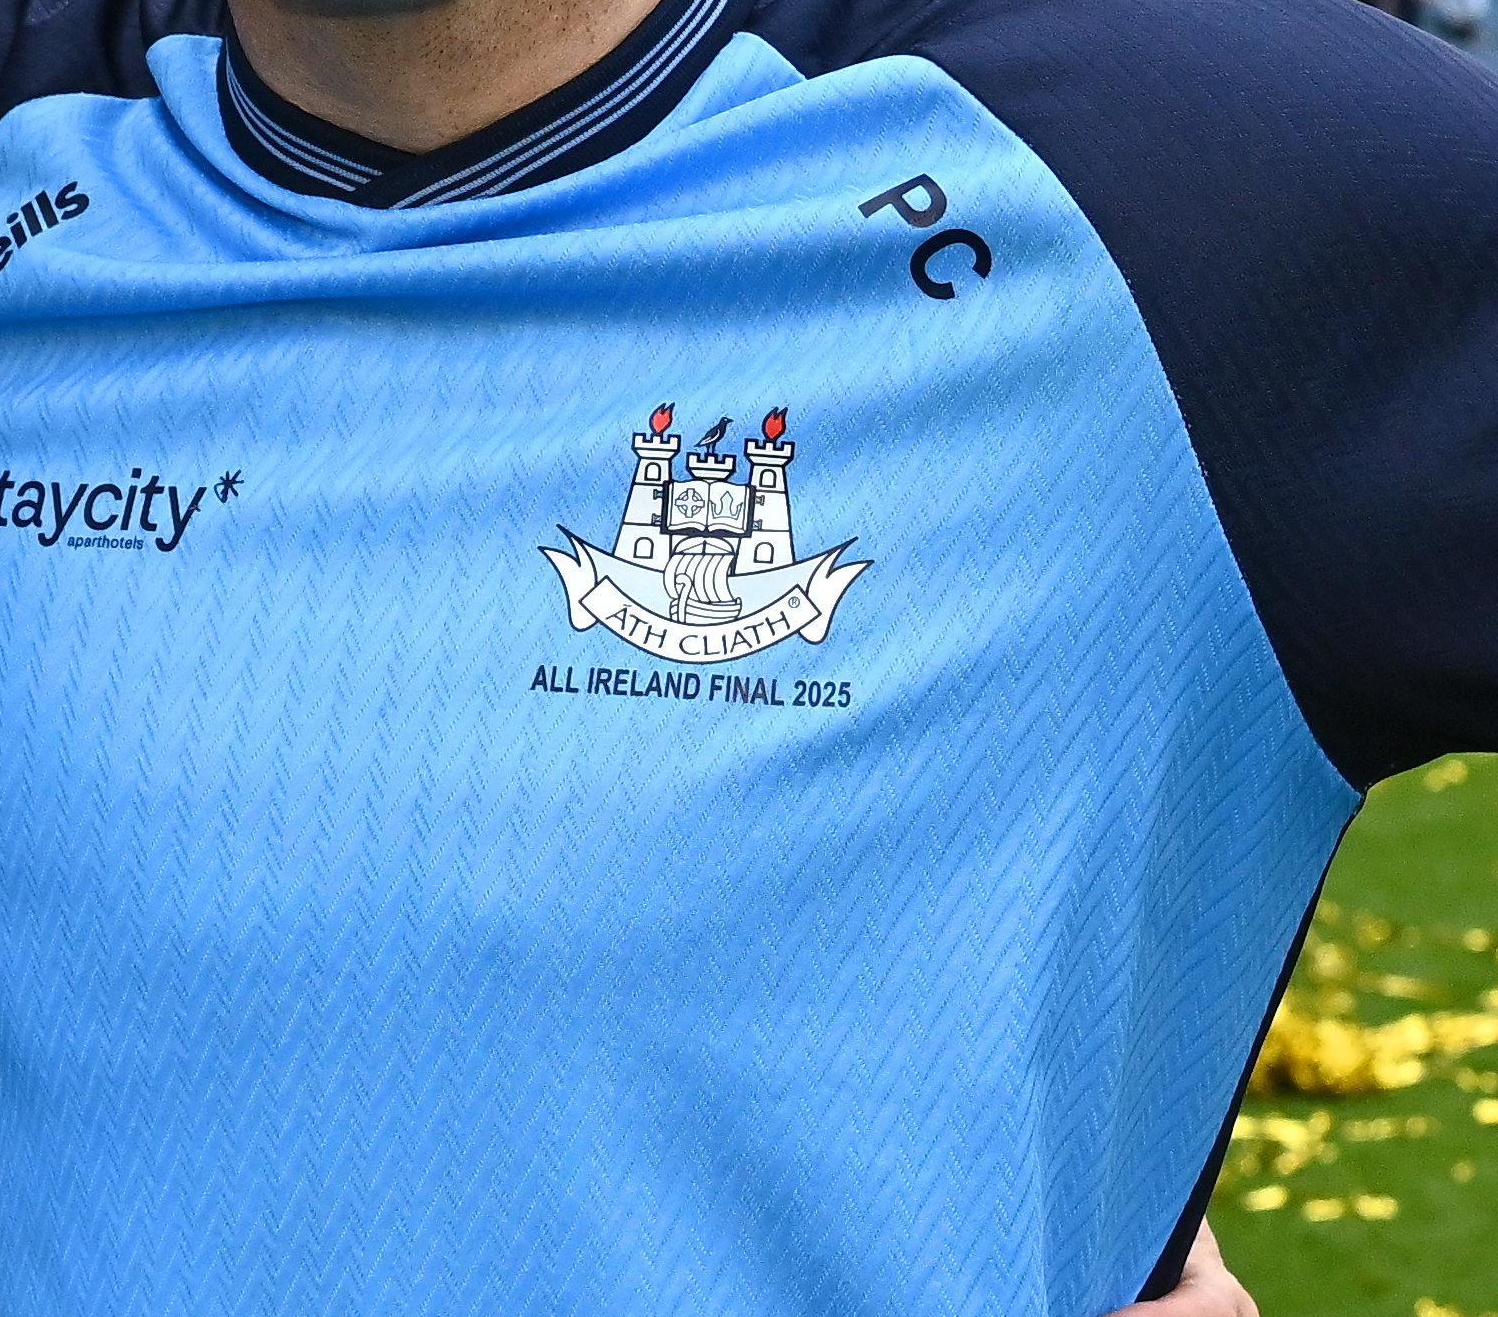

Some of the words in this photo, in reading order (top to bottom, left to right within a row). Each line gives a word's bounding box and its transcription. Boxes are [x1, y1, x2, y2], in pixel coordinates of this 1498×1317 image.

[857, 173, 992, 300] PC
[66, 534, 144, 550] aparthotels
[678, 611, 791, 656] CLIATH
[529, 664, 580, 695] ALL
[586, 667, 701, 700] IRELAND
[708, 674, 785, 707] FINAL
[792, 680, 852, 708] 2025
